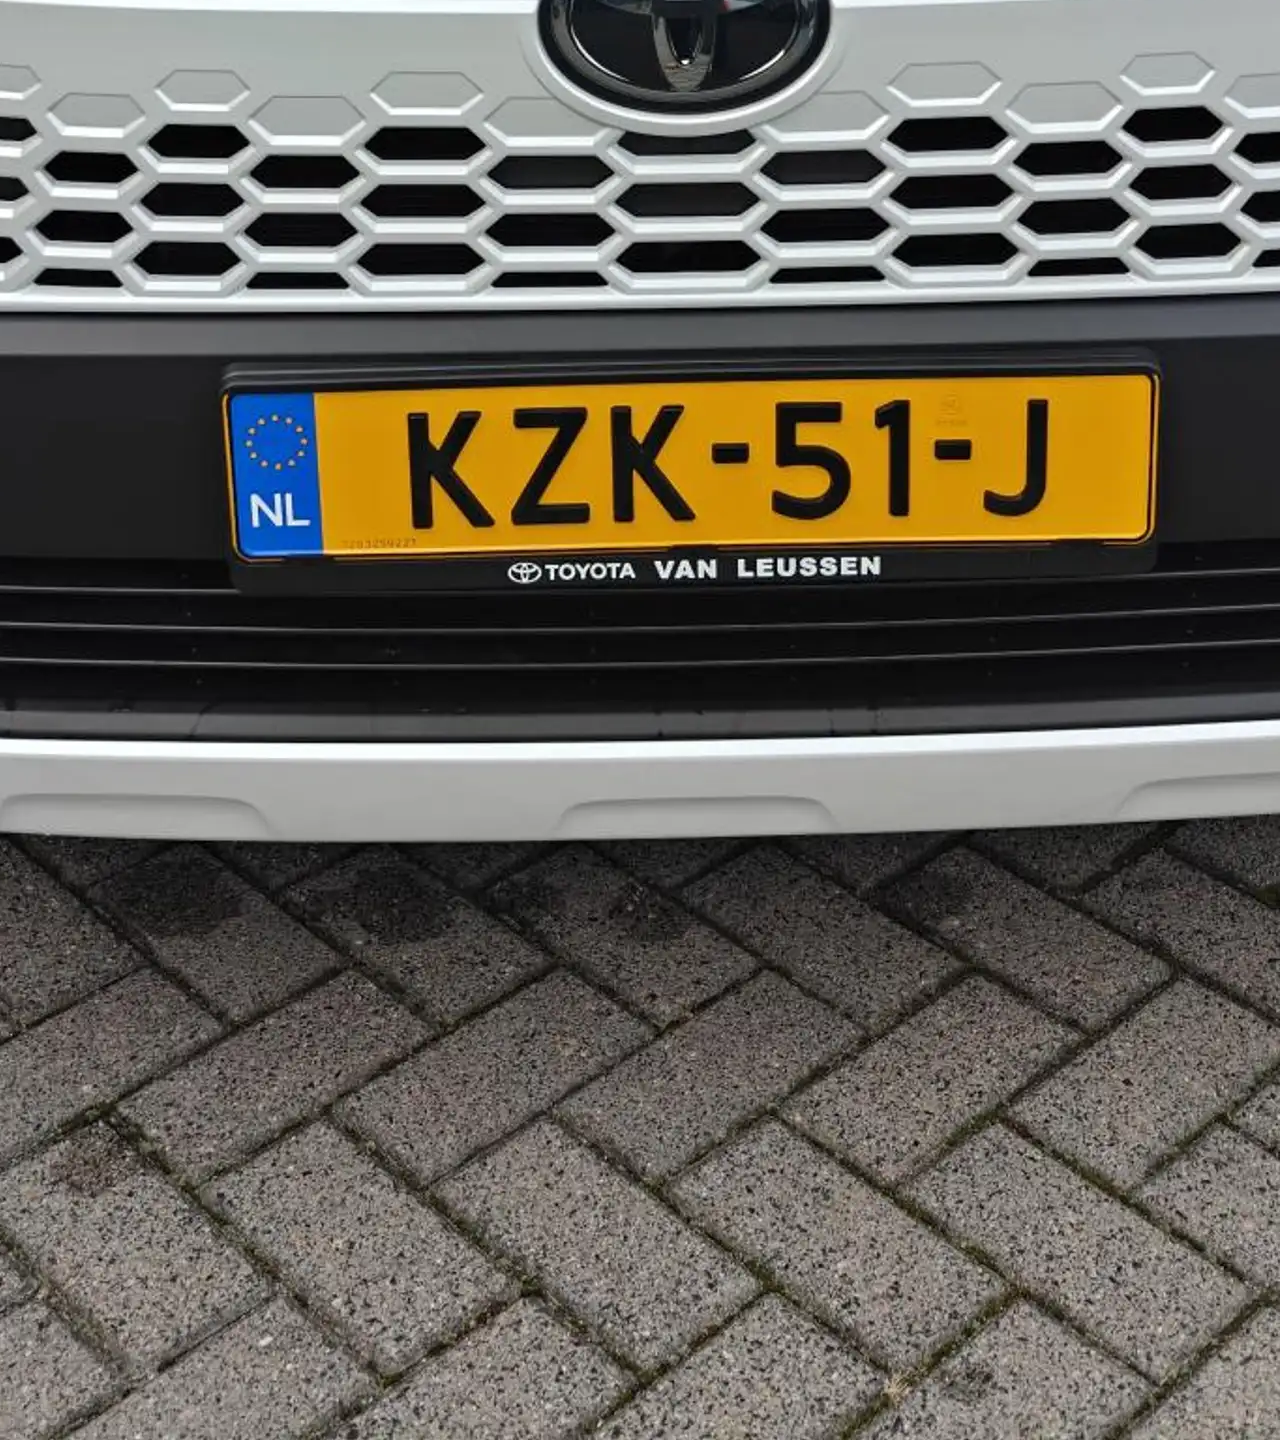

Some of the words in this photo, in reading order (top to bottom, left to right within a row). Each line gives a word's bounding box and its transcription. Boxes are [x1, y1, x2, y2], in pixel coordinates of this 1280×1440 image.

[404, 398, 1051, 530] KZK-51-J
[249, 492, 312, 528] NL
[544, 561, 637, 581] TOYOTA
[654, 559, 718, 580] VAN
[737, 556, 882, 578] LEUSSEN
